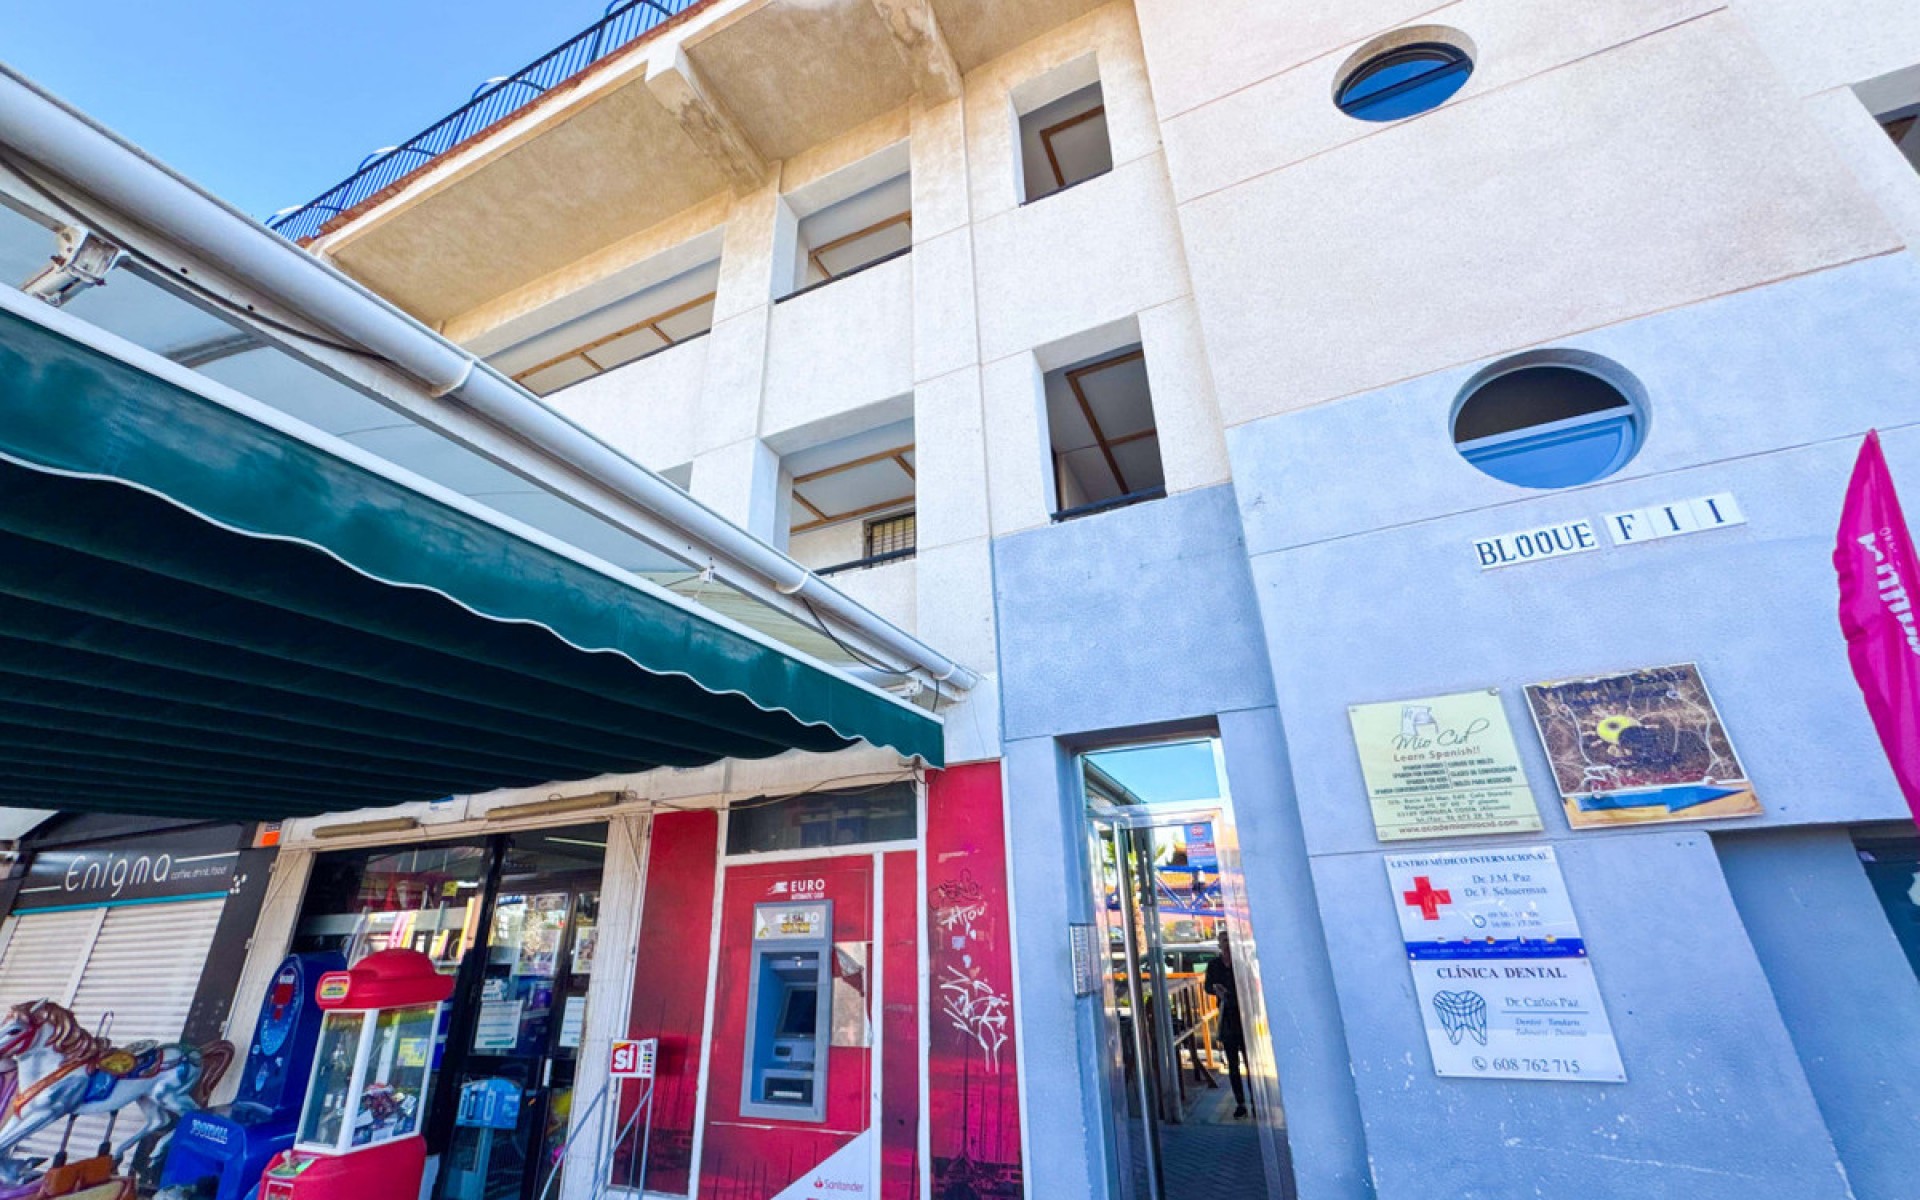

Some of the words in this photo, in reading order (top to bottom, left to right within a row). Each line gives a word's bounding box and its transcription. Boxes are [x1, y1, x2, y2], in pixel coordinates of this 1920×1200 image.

[1391, 733, 1431, 751] Mio
[1437, 718, 1490, 747] Cid
[1394, 752, 1425, 763] Learn
[1429, 746, 1481, 760] Spanish!!
[1390, 858, 1428, 869] CENTRO
[1430, 855, 1468, 866] MÉDICO
[1469, 853, 1550, 864] INTERNACIONAL
[65, 853, 171, 898] Enigma
[1472, 874, 1486, 884] Dr.
[1513, 873, 1531, 883] Paz
[791, 878, 825, 892] EURO
[1464, 887, 1480, 897] Dr.
[1436, 964, 1499, 979] CLÍNICA
[1504, 967, 1568, 979] DENTAL
[1505, 997, 1521, 1008] Dr.
[1523, 996, 1558, 1008] Carlos
[1559, 997, 1579, 1008] Paz
[1492, 1058, 1519, 1072] 608
[1524, 1058, 1550, 1072] 762
[1554, 1059, 1581, 1073] 715
[824, 1179, 864, 1193] Santander
